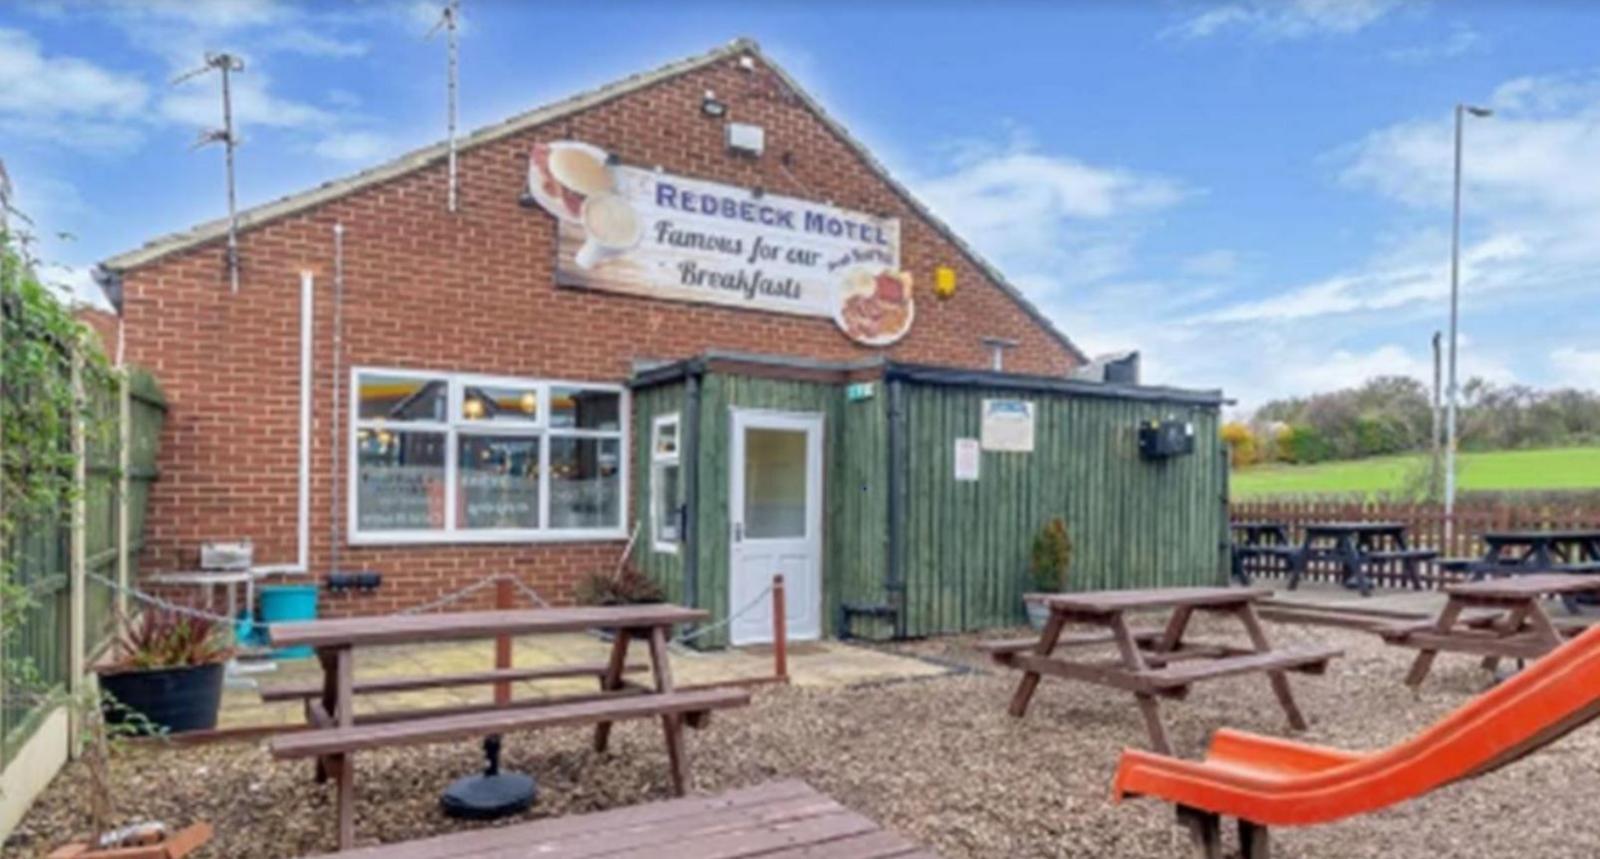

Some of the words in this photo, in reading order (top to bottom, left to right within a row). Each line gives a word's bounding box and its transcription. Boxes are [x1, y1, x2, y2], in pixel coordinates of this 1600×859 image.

[655, 182, 794, 230] REDBECK
[804, 210, 888, 246] MOTEL
[655, 220, 743, 255] Famous
[747, 236, 783, 265] for
[786, 248, 822, 266] our
[676, 260, 802, 300] Breakfasts
